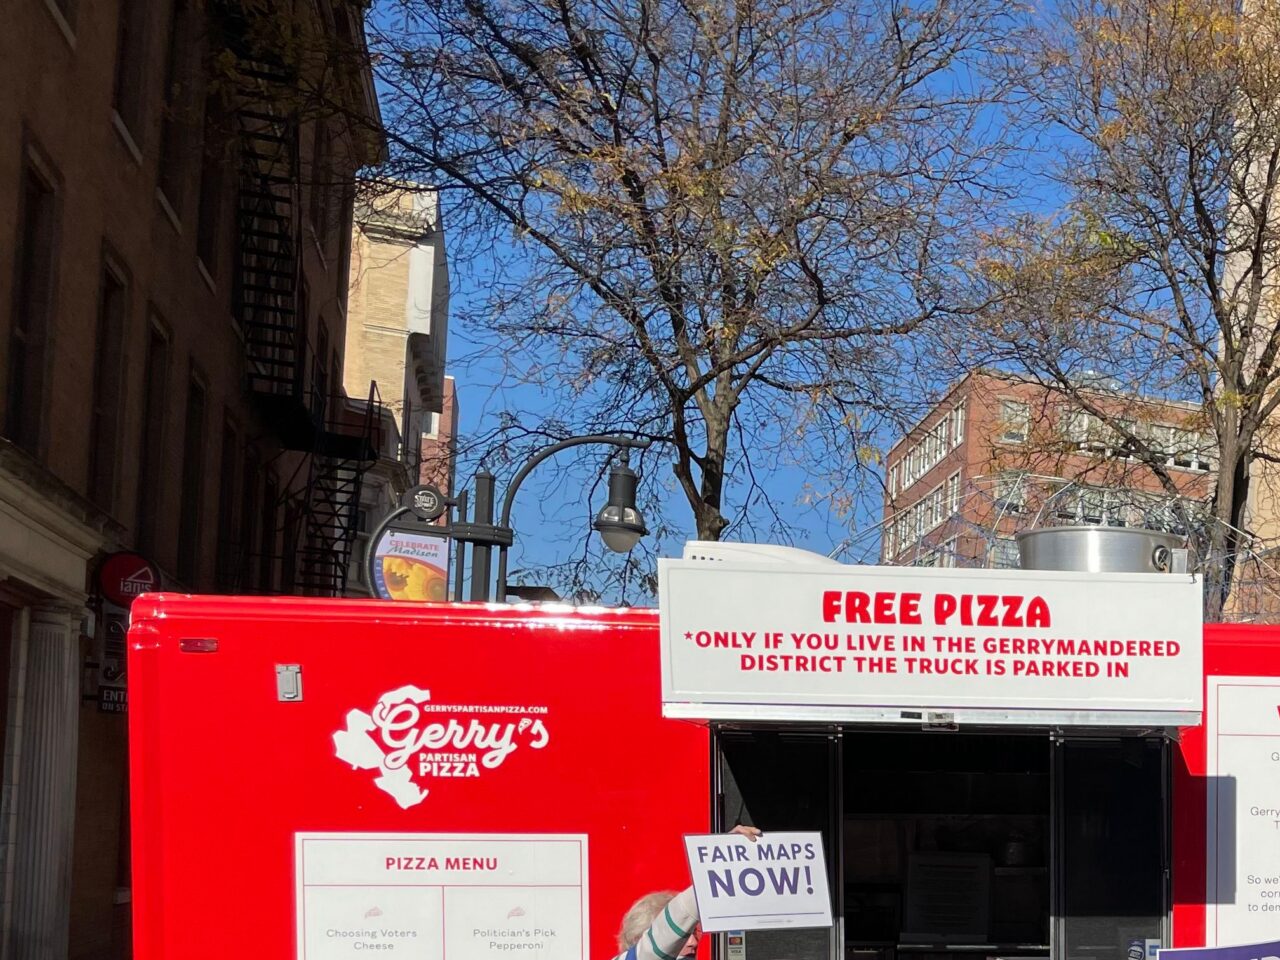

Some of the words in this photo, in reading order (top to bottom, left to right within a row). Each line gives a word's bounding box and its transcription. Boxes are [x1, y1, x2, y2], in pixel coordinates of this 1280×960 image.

[389, 540, 439, 551] CELEBRATE
[822, 590, 922, 625] FREE
[934, 593, 1052, 628] PIZZA
[764, 632, 783, 649] IF
[790, 633, 838, 650] YOU
[846, 634, 895, 651] LIVE
[902, 635, 925, 652] IN
[932, 636, 976, 653] THE
[982, 637, 1180, 656] GERRYMANDERED
[740, 654, 846, 672] DISTRICT
[852, 656, 897, 673] THE
[903, 657, 978, 675] TRUCK
[986, 659, 1006, 676] IS
[1012, 660, 1100, 677] PARKED
[1106, 661, 1128, 678] IN
[424, 704, 549, 714] GERRYSPARTISANPIZZA.COM
[371, 700, 550, 770] Gerry's
[419, 753, 477, 762] PARTISAN
[419, 762, 480, 777] PIZZA
[697, 844, 749, 864] FAIR
[757, 843, 816, 861] MAPS
[385, 857, 439, 870] PIZZA
[444, 857, 497, 870] MENU
[706, 865, 815, 898] NOW!
[325, 928, 377, 939] Choosing
[380, 928, 417, 938] Voters
[472, 928, 530, 937] Politician's
[533, 928, 556, 937] Pick
[353, 941, 394, 950] Cheese
[489, 941, 543, 951] Pepperoni
